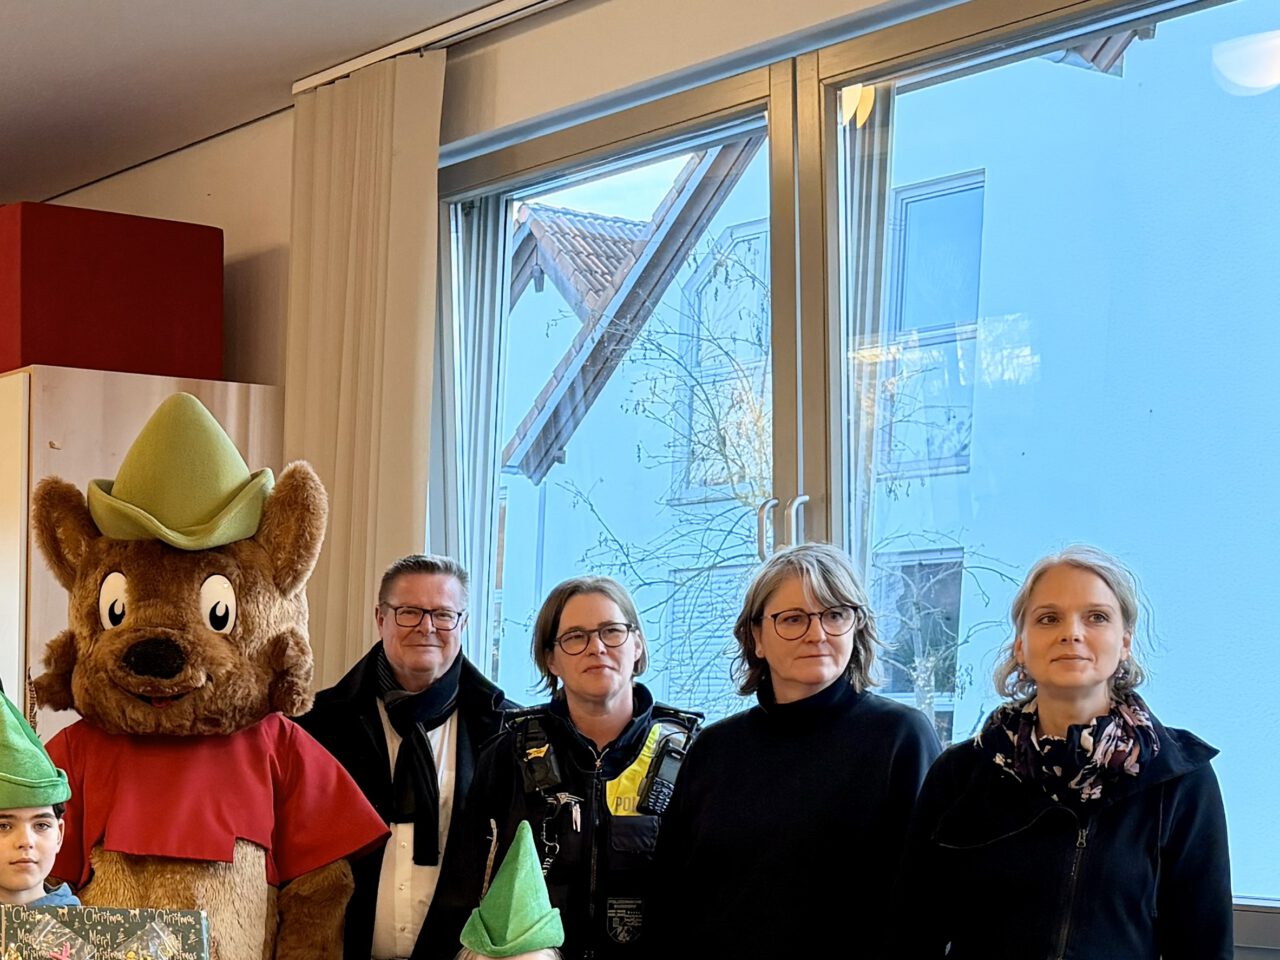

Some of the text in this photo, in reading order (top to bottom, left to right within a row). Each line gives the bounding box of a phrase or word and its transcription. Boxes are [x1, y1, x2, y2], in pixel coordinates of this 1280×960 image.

[84, 908, 124, 925] Christmas
[155, 909, 195, 925] Christmas
[89, 930, 111, 947] Merry
